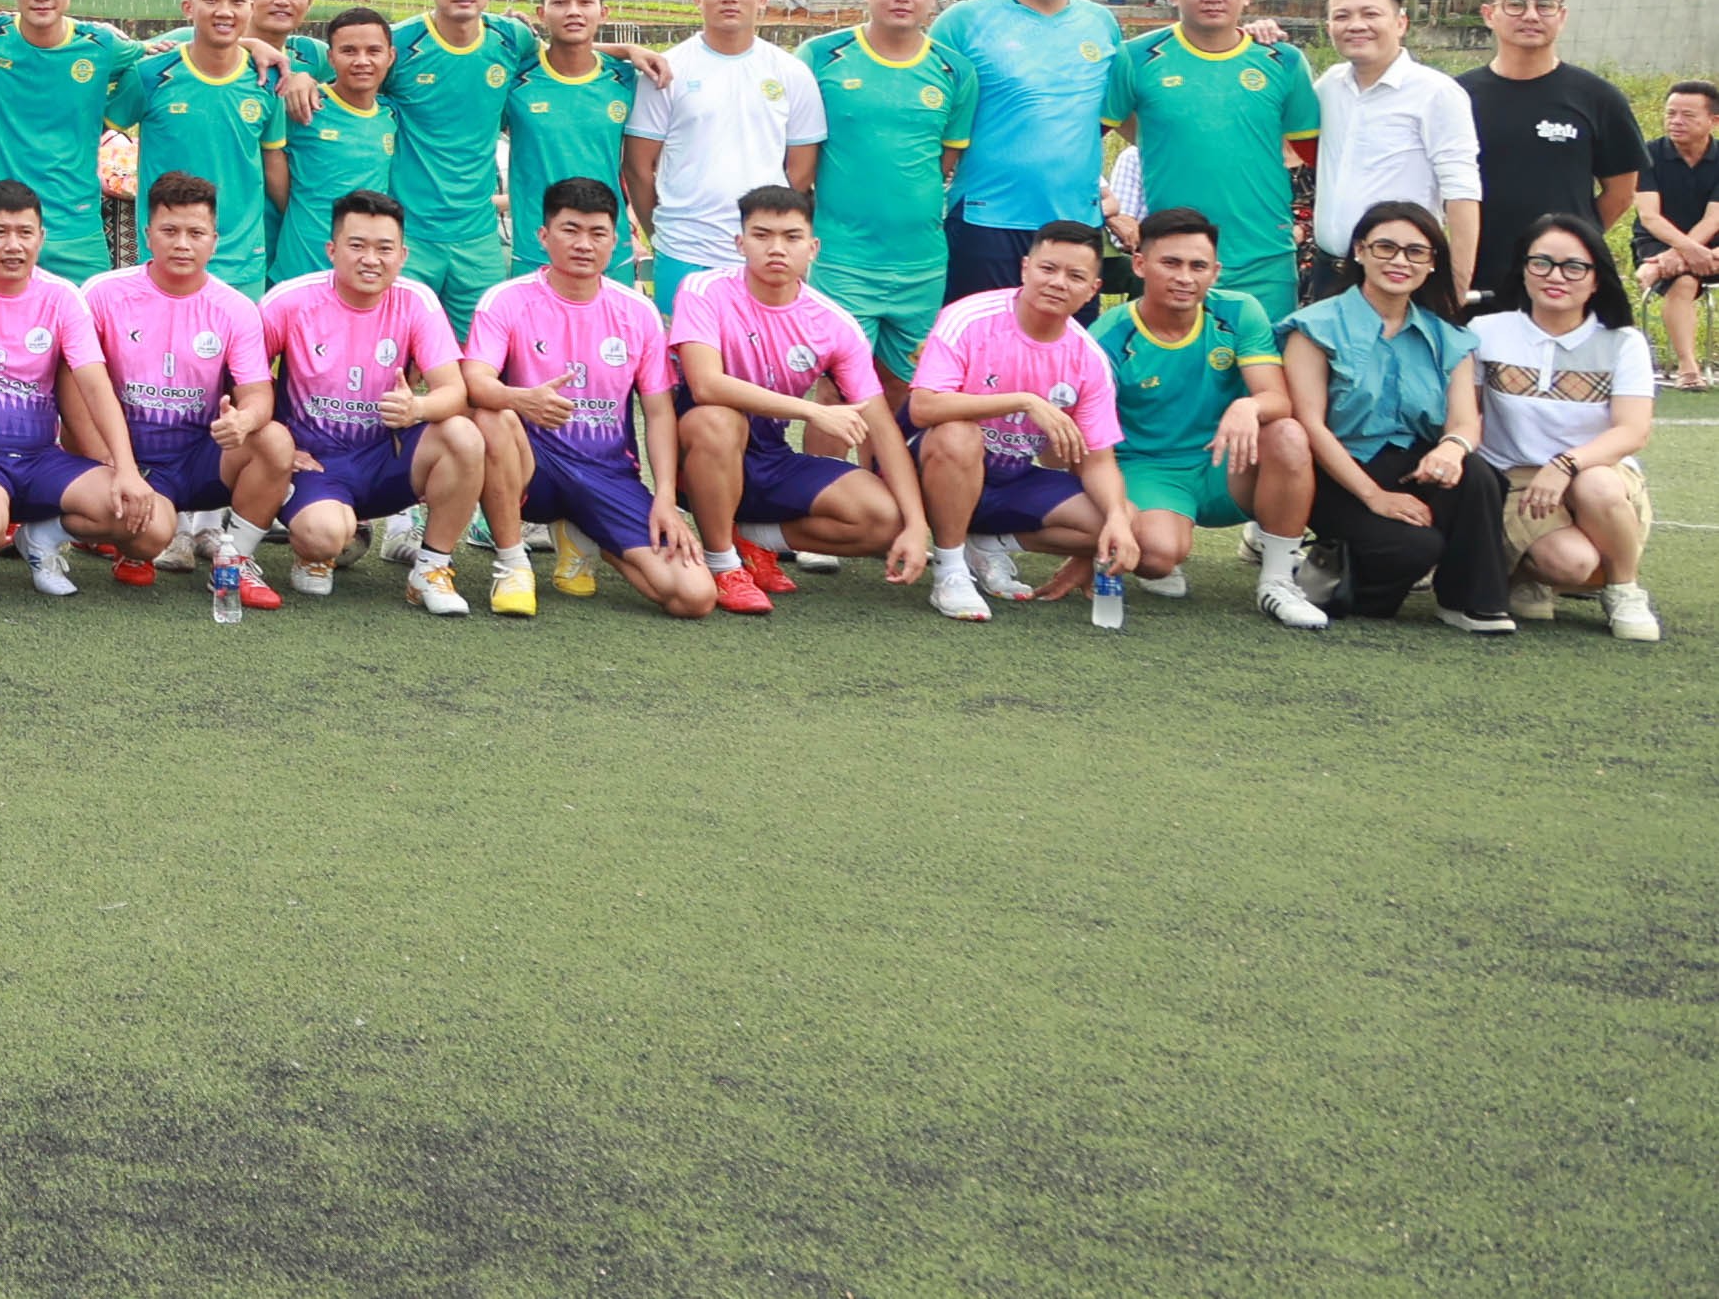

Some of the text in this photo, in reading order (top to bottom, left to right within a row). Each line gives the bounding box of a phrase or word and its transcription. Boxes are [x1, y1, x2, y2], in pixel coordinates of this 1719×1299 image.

[346, 365, 364, 392] 9
[126, 383, 205, 399] HTQ GROUP
[310, 395, 380, 413] HTQ GROU
